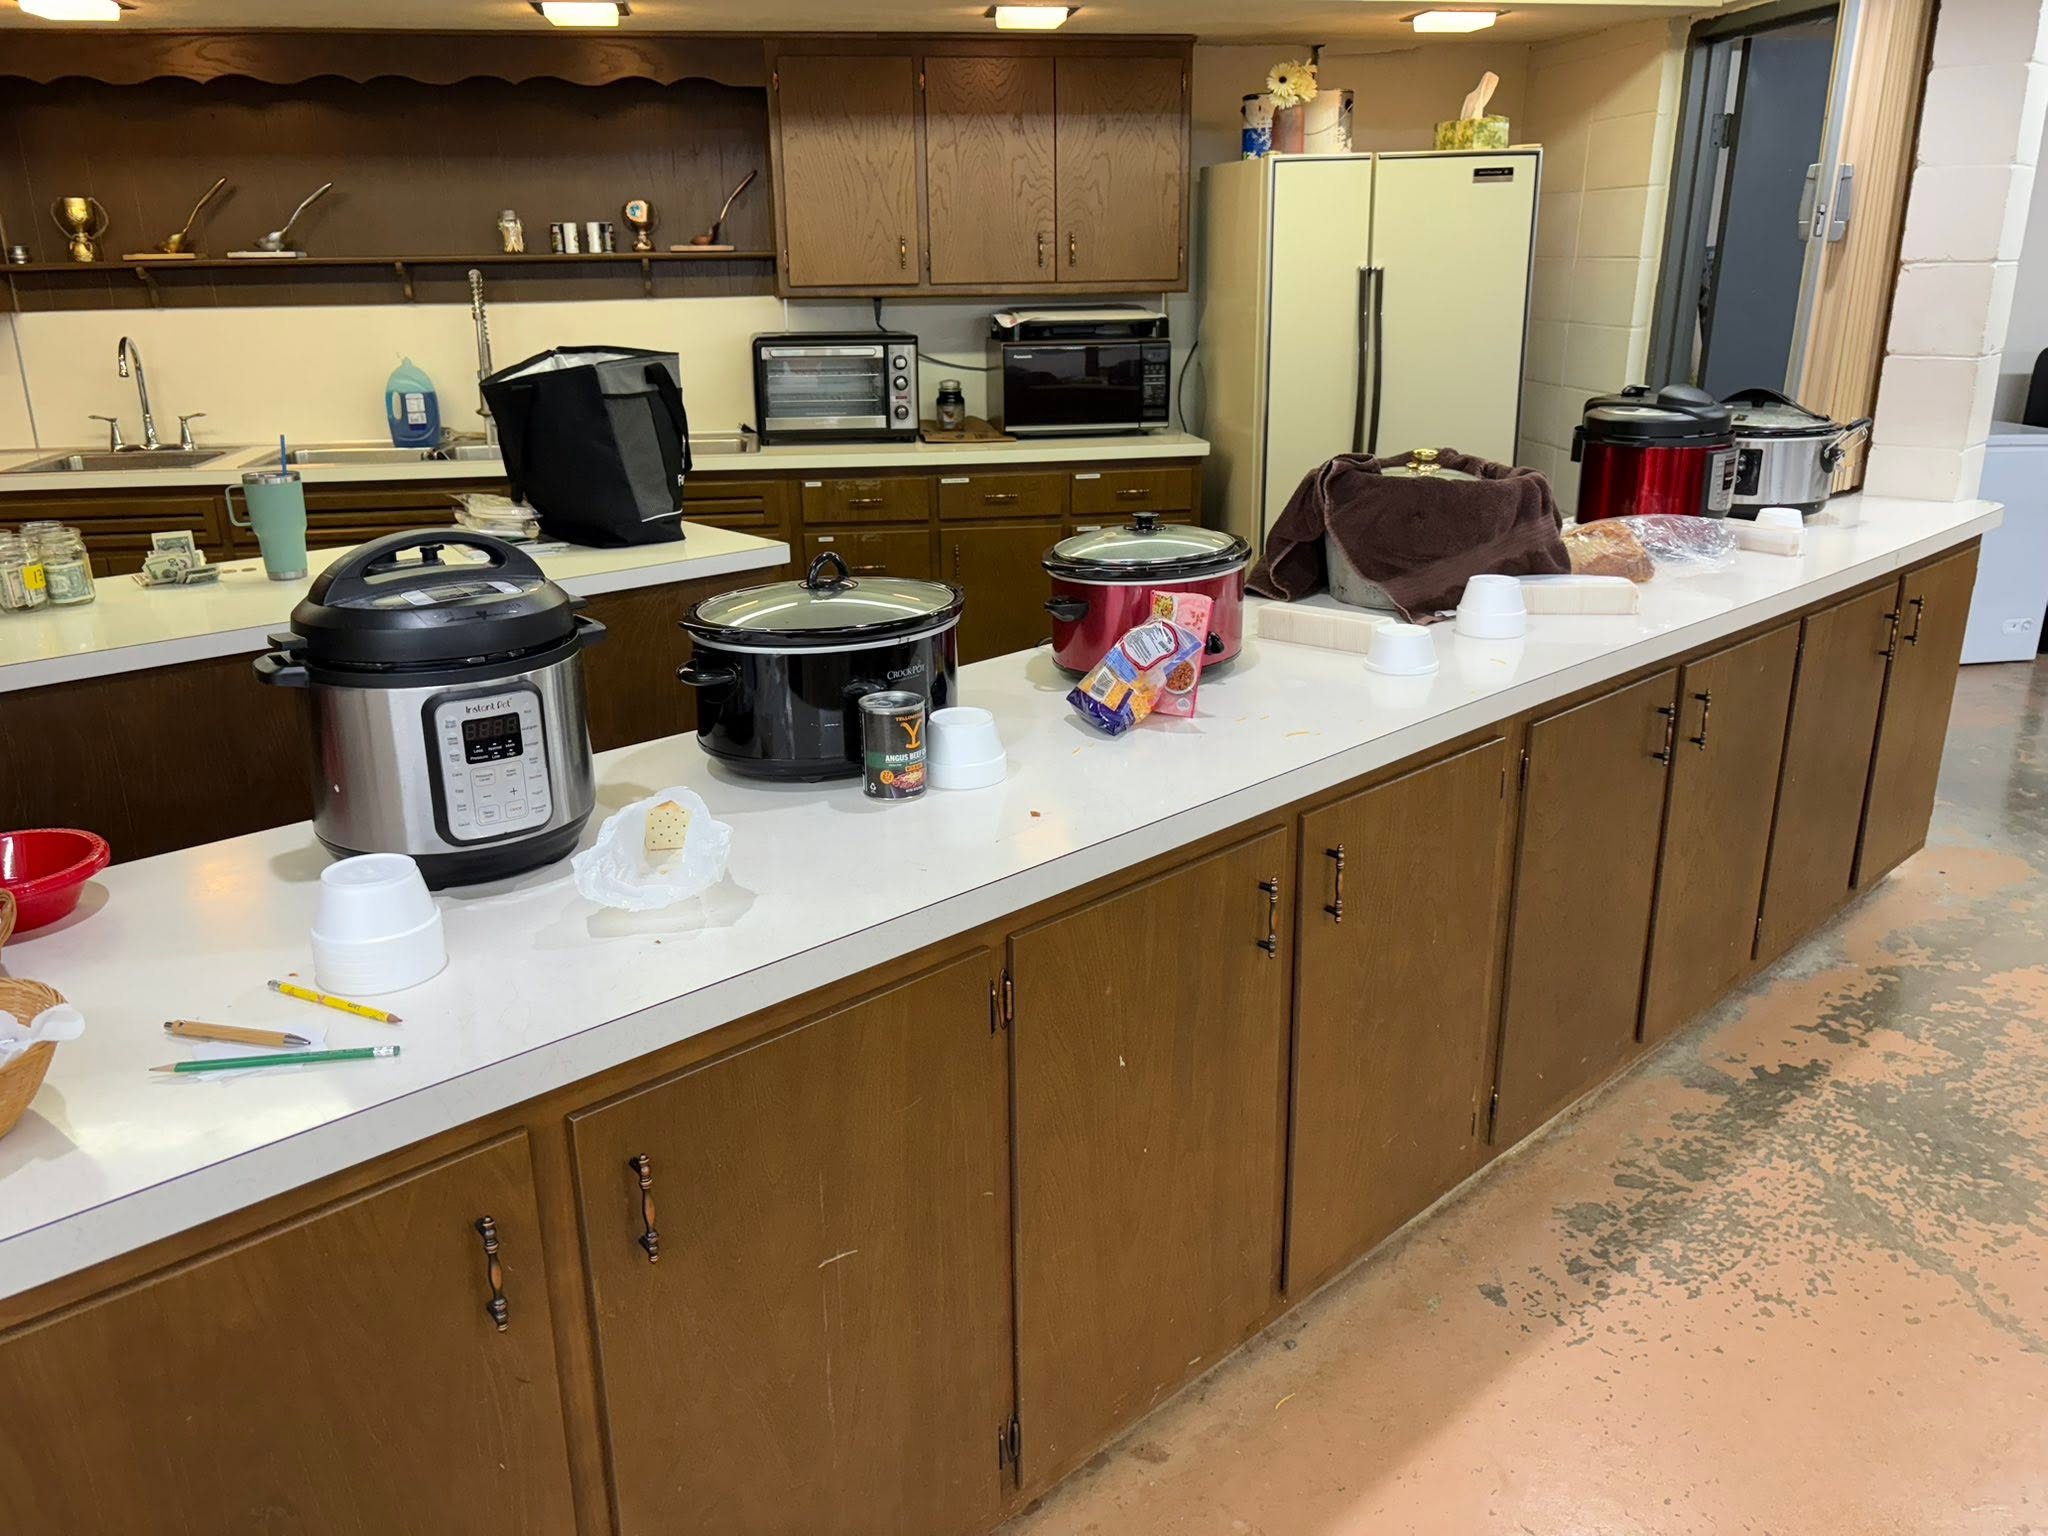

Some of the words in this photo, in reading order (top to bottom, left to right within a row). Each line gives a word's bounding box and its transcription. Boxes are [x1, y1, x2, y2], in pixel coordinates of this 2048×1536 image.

[465, 703, 495, 713] Instant
[497, 700, 511, 709] Pot
[885, 753, 909, 762] ANGUS
[909, 749, 922, 759] BEEF
